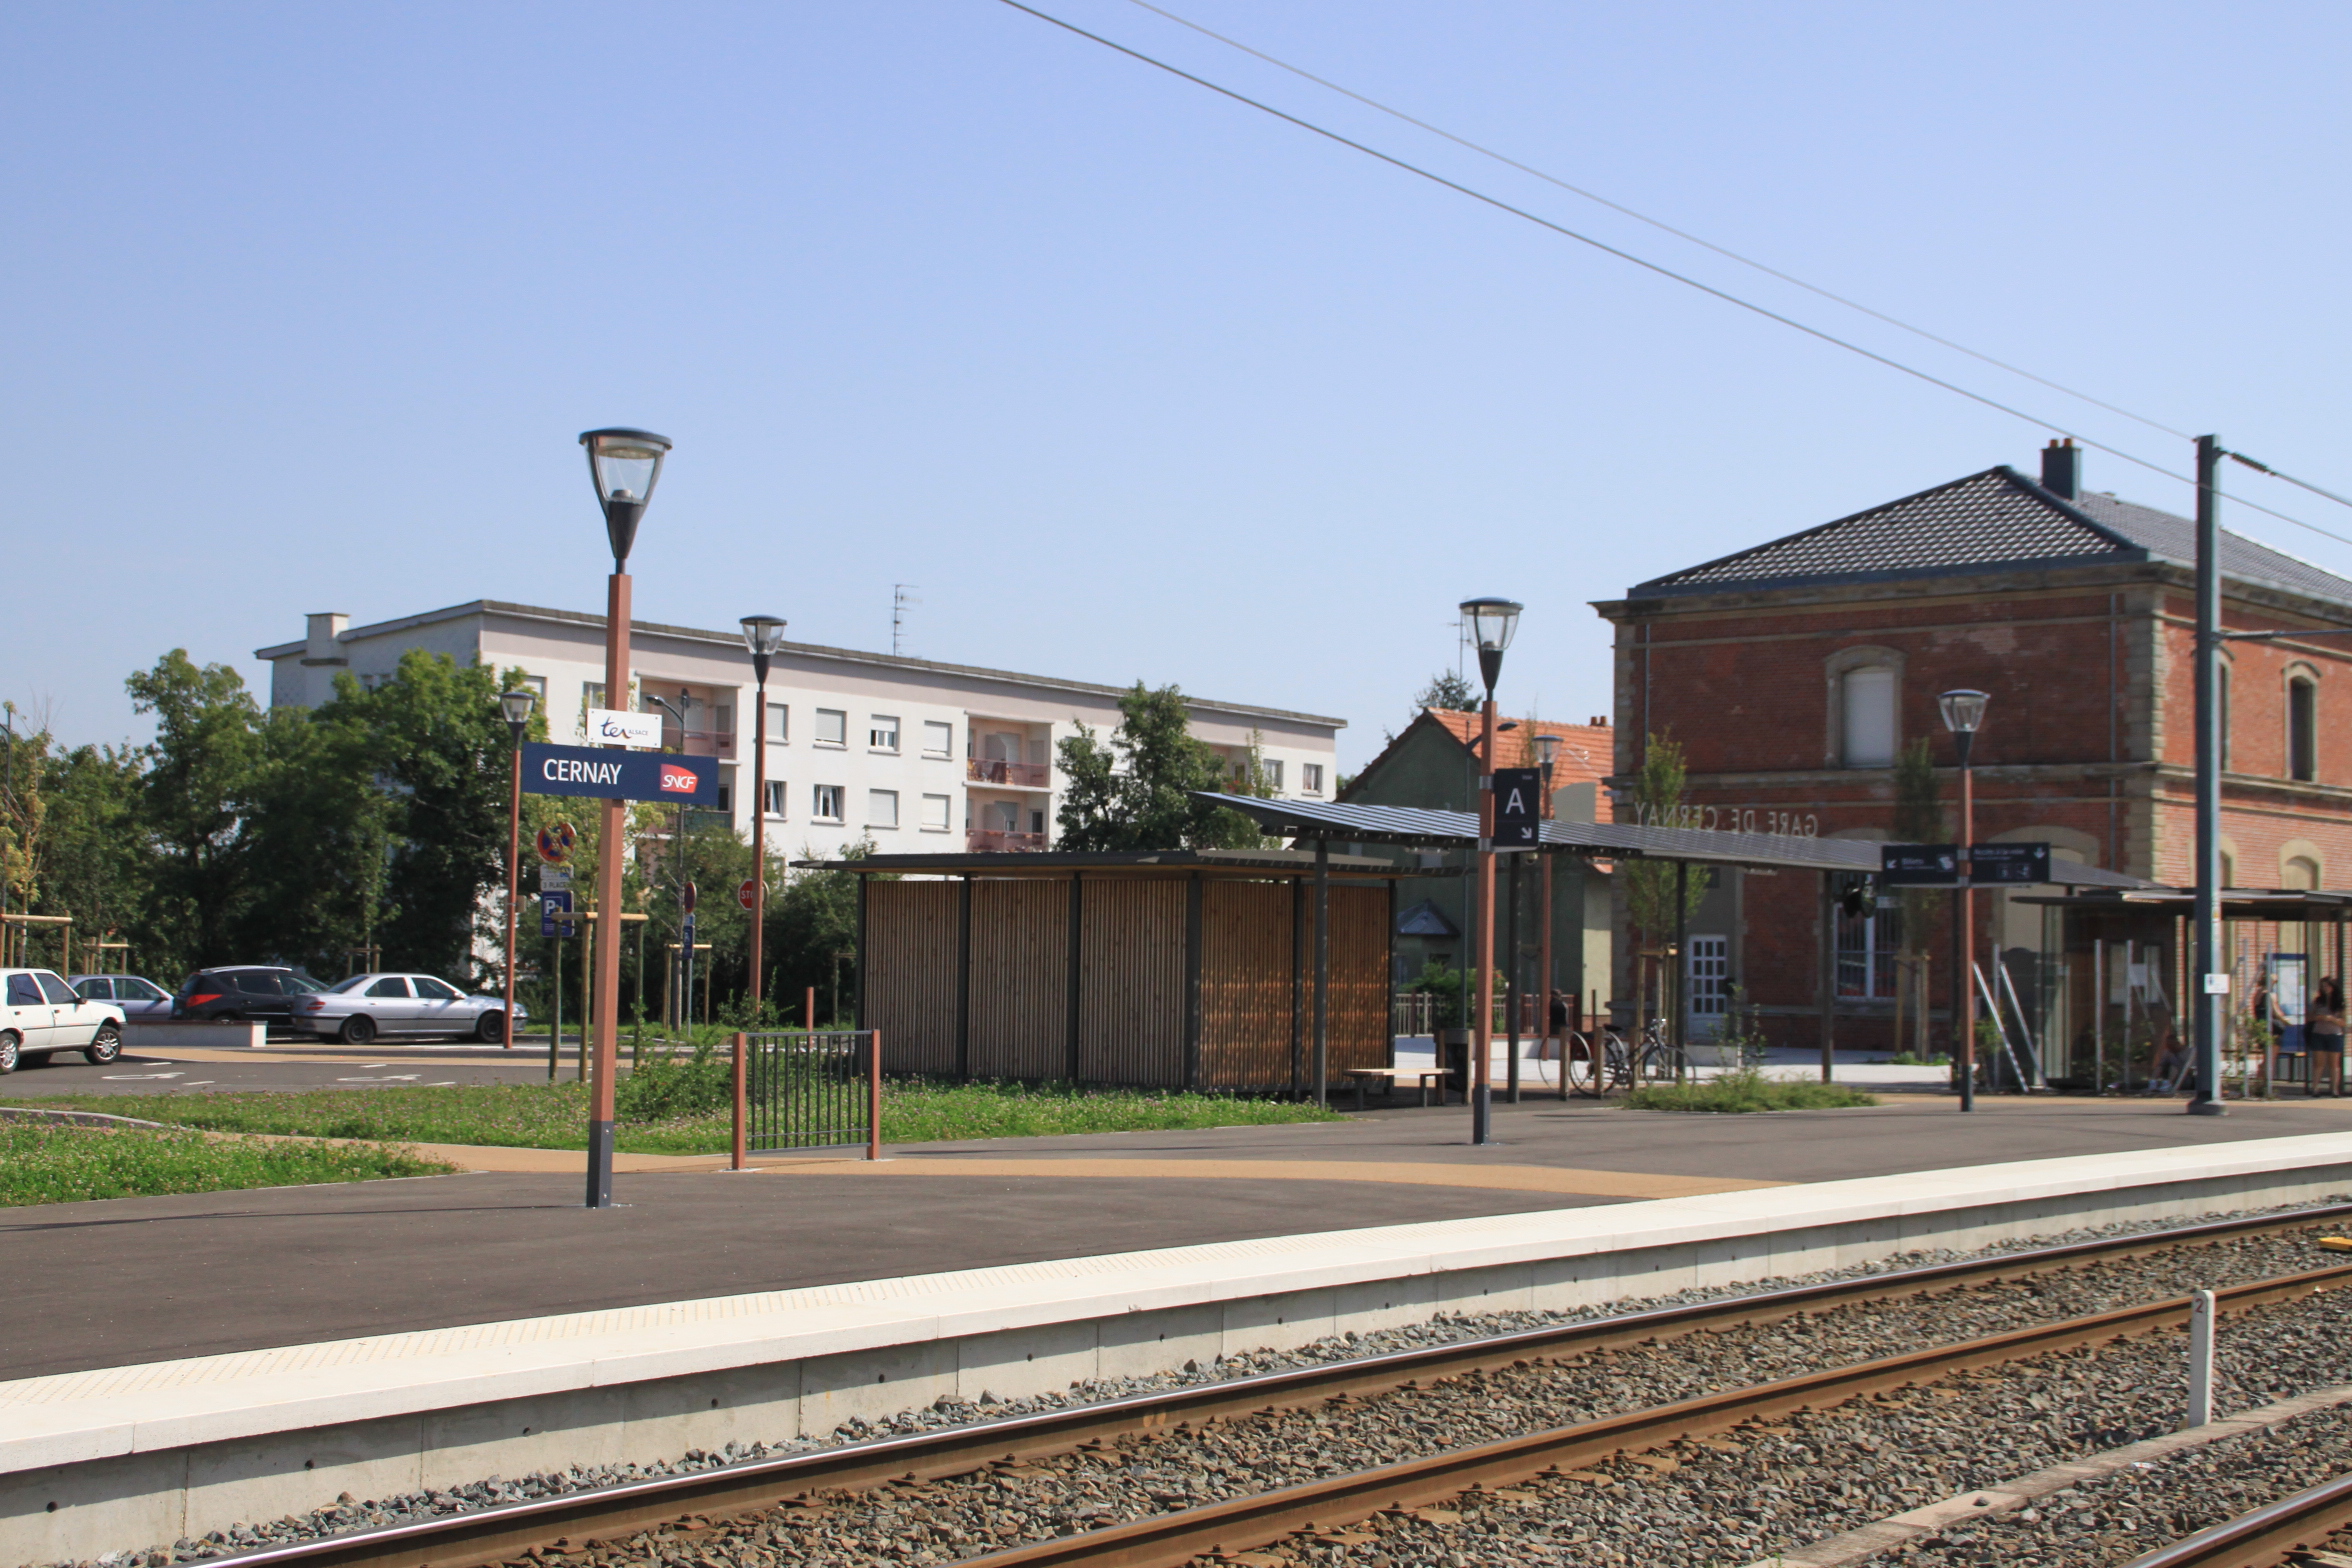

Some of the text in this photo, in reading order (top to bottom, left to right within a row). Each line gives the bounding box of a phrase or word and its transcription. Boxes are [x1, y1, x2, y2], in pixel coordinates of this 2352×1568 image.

[600, 716, 632, 739] ter
[543, 758, 622, 785] CERNAY
[662, 774, 697, 789] SNCF
[1505, 788, 1525, 814] A
[545, 899, 556, 915] P
[2195, 1298, 2203, 1313] 2
